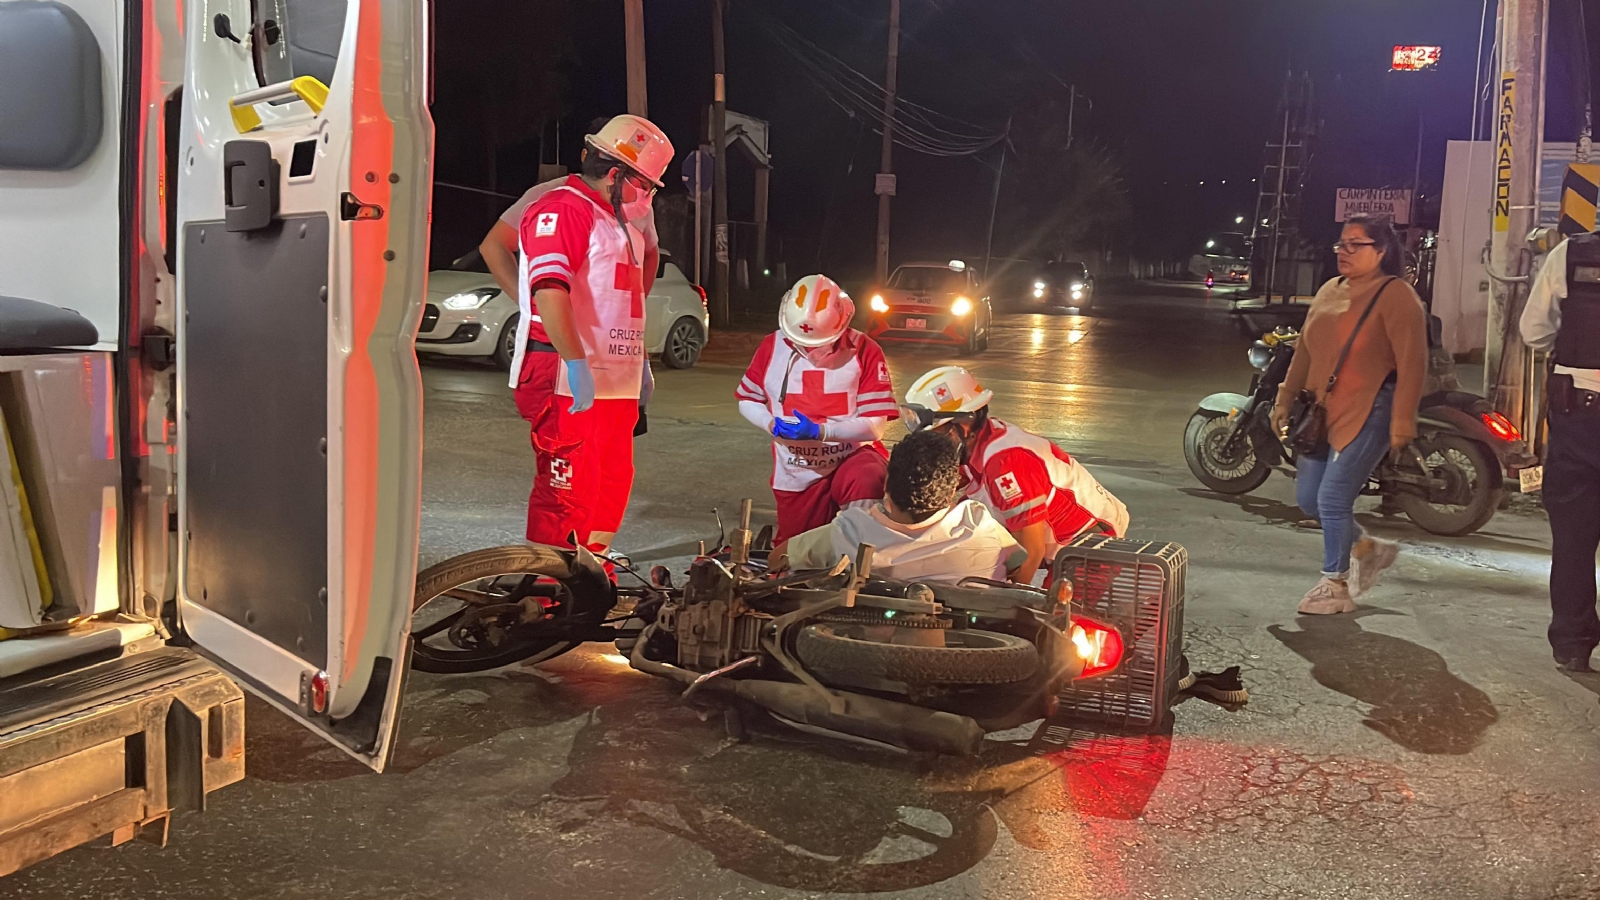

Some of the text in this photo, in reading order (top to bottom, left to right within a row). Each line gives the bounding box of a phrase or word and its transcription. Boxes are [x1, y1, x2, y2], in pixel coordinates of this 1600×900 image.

[1496, 78, 1514, 216] FARMACON
[1339, 188, 1405, 200] CARPINTERIA
[1345, 202, 1394, 212] MUEBLERIA
[609, 328, 635, 340] CRUZ
[788, 442, 853, 456] CRUZ ROJA
